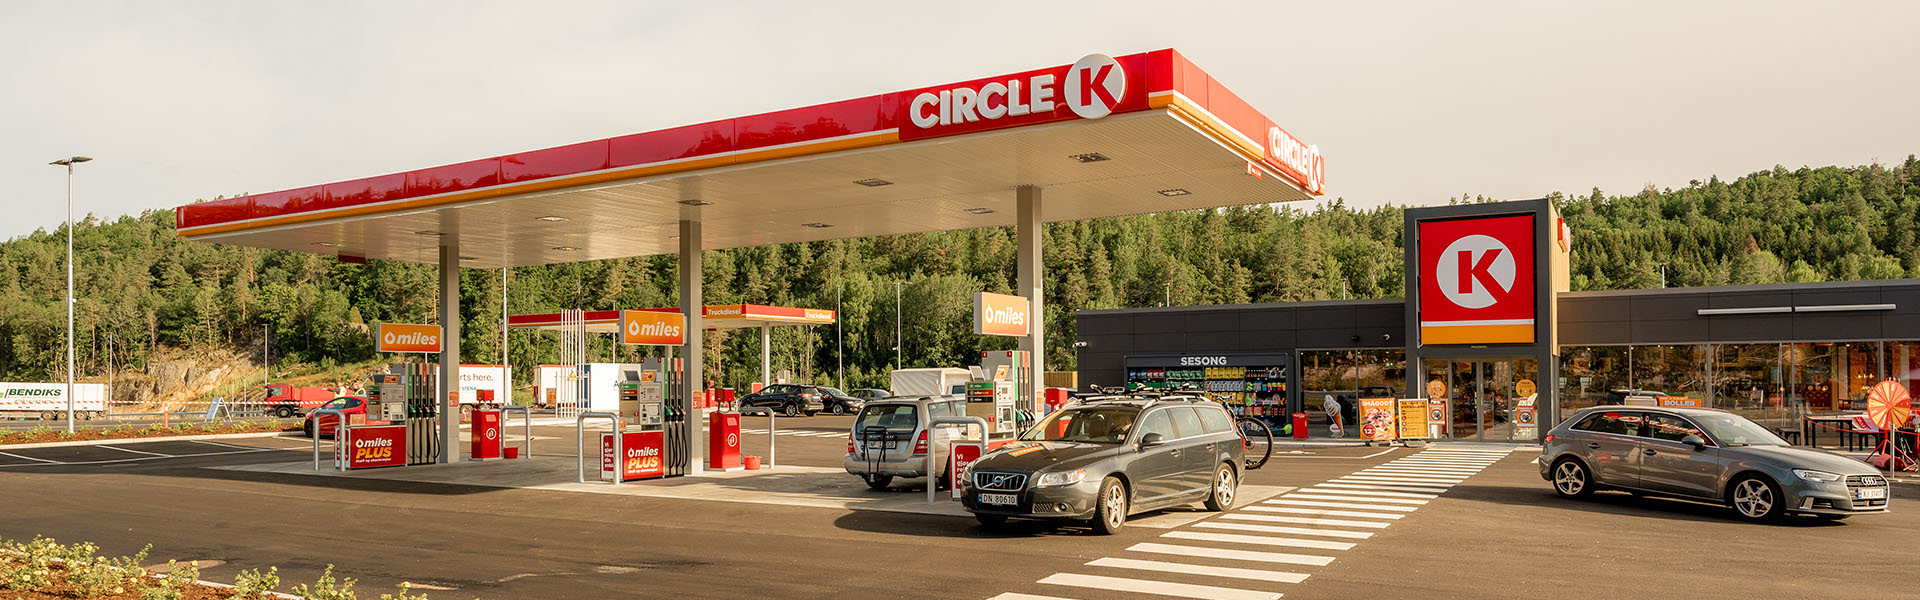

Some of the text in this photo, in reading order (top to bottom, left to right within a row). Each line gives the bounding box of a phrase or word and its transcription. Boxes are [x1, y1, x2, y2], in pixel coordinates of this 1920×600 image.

[910, 60, 1123, 128] CIRCLE K
[1268, 126, 1308, 176] CIRCLE
[1452, 244, 1511, 305] K
[994, 306, 1024, 326] miles
[640, 321, 680, 337] miles
[396, 331, 437, 345] miles
[1180, 356, 1227, 366] SESONG
[473, 373, 494, 381] here.
[8, 388, 62, 396] BENDIKS
[364, 437, 392, 448] miles
[356, 446, 392, 459] PLUS
[635, 446, 659, 457] miles
[628, 456, 659, 470] PLUS
[983, 494, 993, 502] DN
